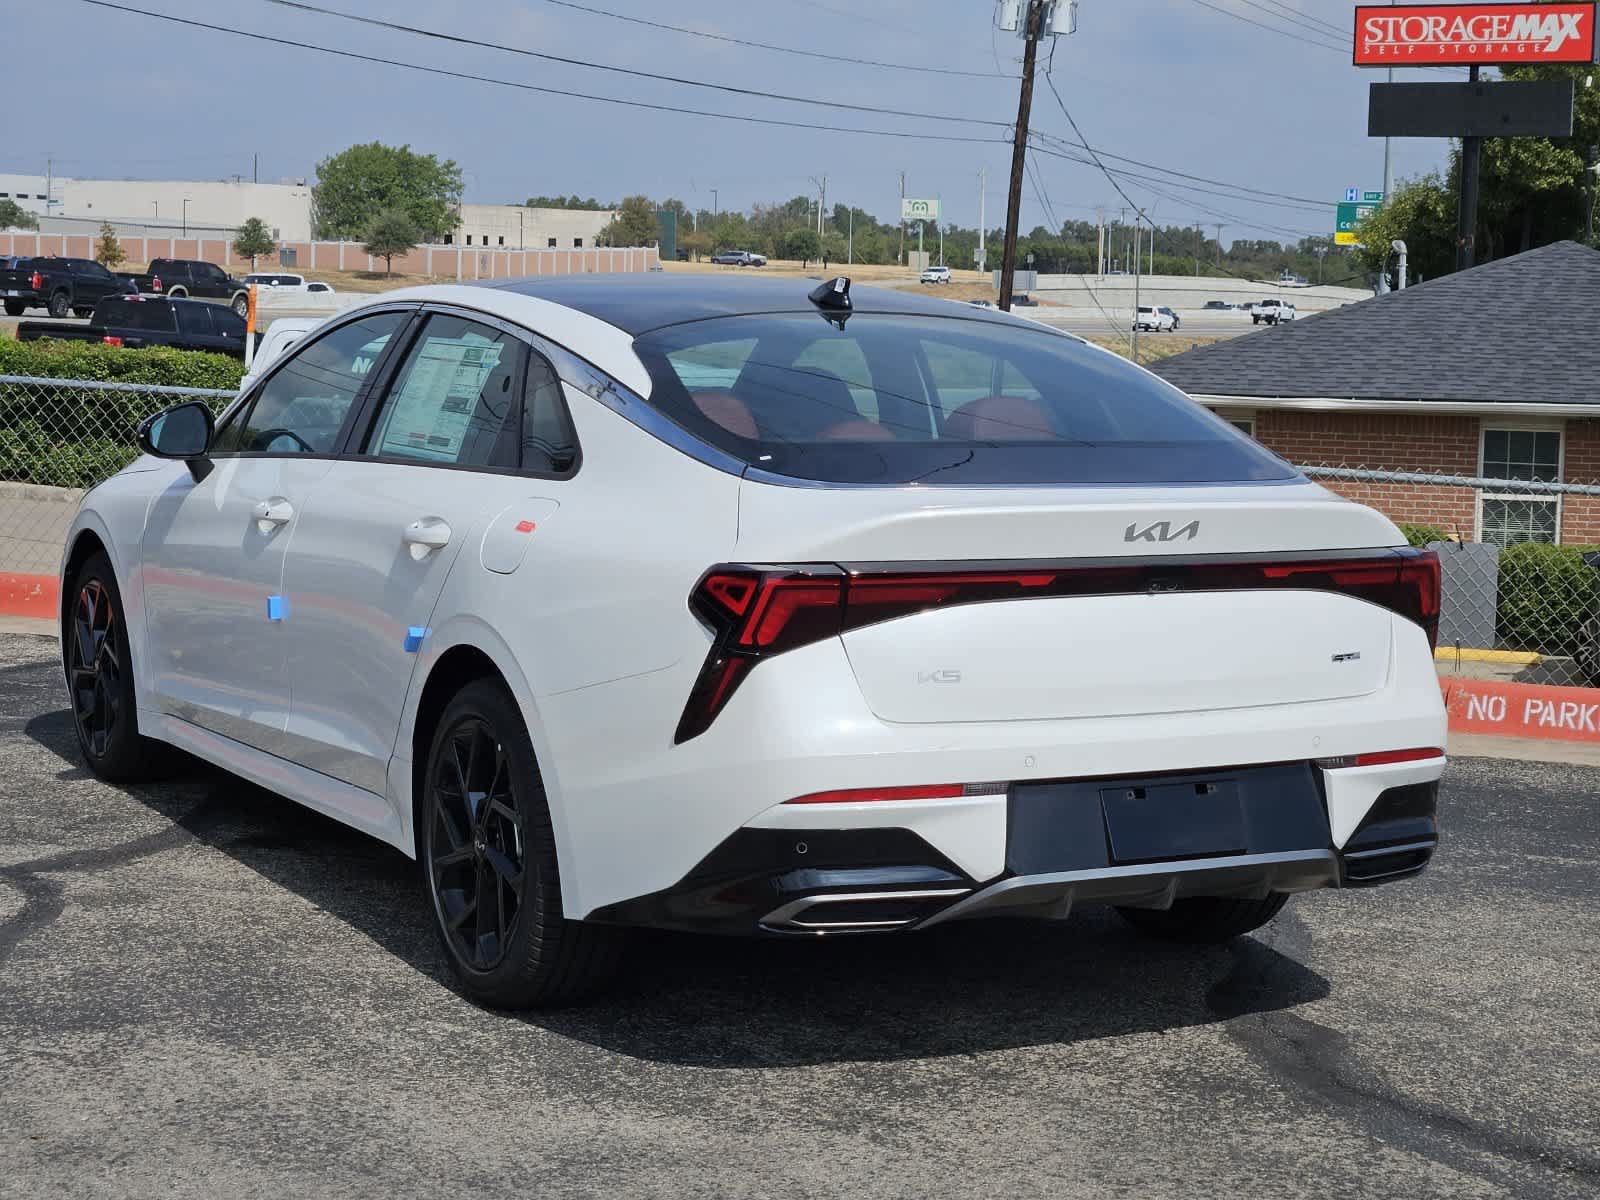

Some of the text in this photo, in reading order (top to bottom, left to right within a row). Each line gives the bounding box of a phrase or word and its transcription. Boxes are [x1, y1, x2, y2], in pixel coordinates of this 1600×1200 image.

[1364, 44, 1541, 54] SELF STORAGE
[1124, 520, 1200, 541] KIA
[1467, 693, 1600, 732] NO PARK
